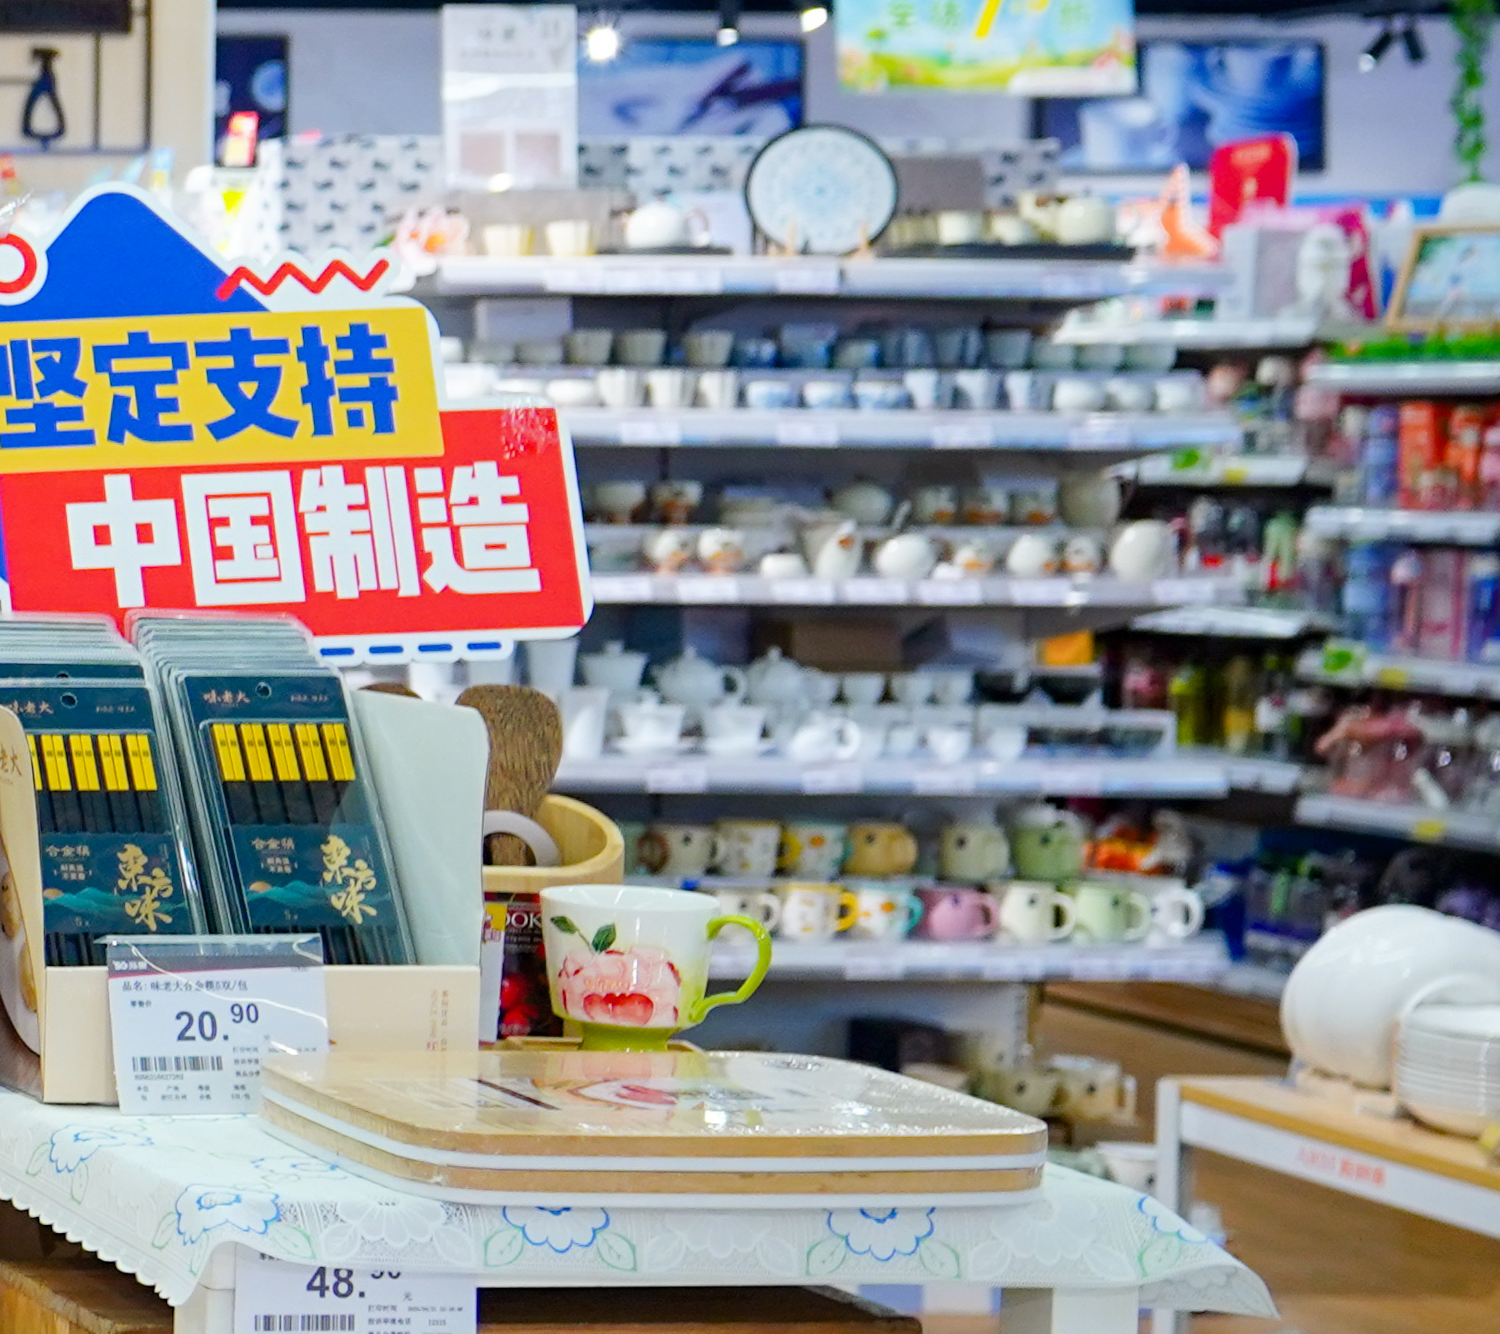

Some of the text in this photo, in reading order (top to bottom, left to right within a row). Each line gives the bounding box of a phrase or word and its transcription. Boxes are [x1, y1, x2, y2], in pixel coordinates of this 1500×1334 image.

[66, 461, 541, 609] 中国制造
[203, 690, 250, 705] 味老大
